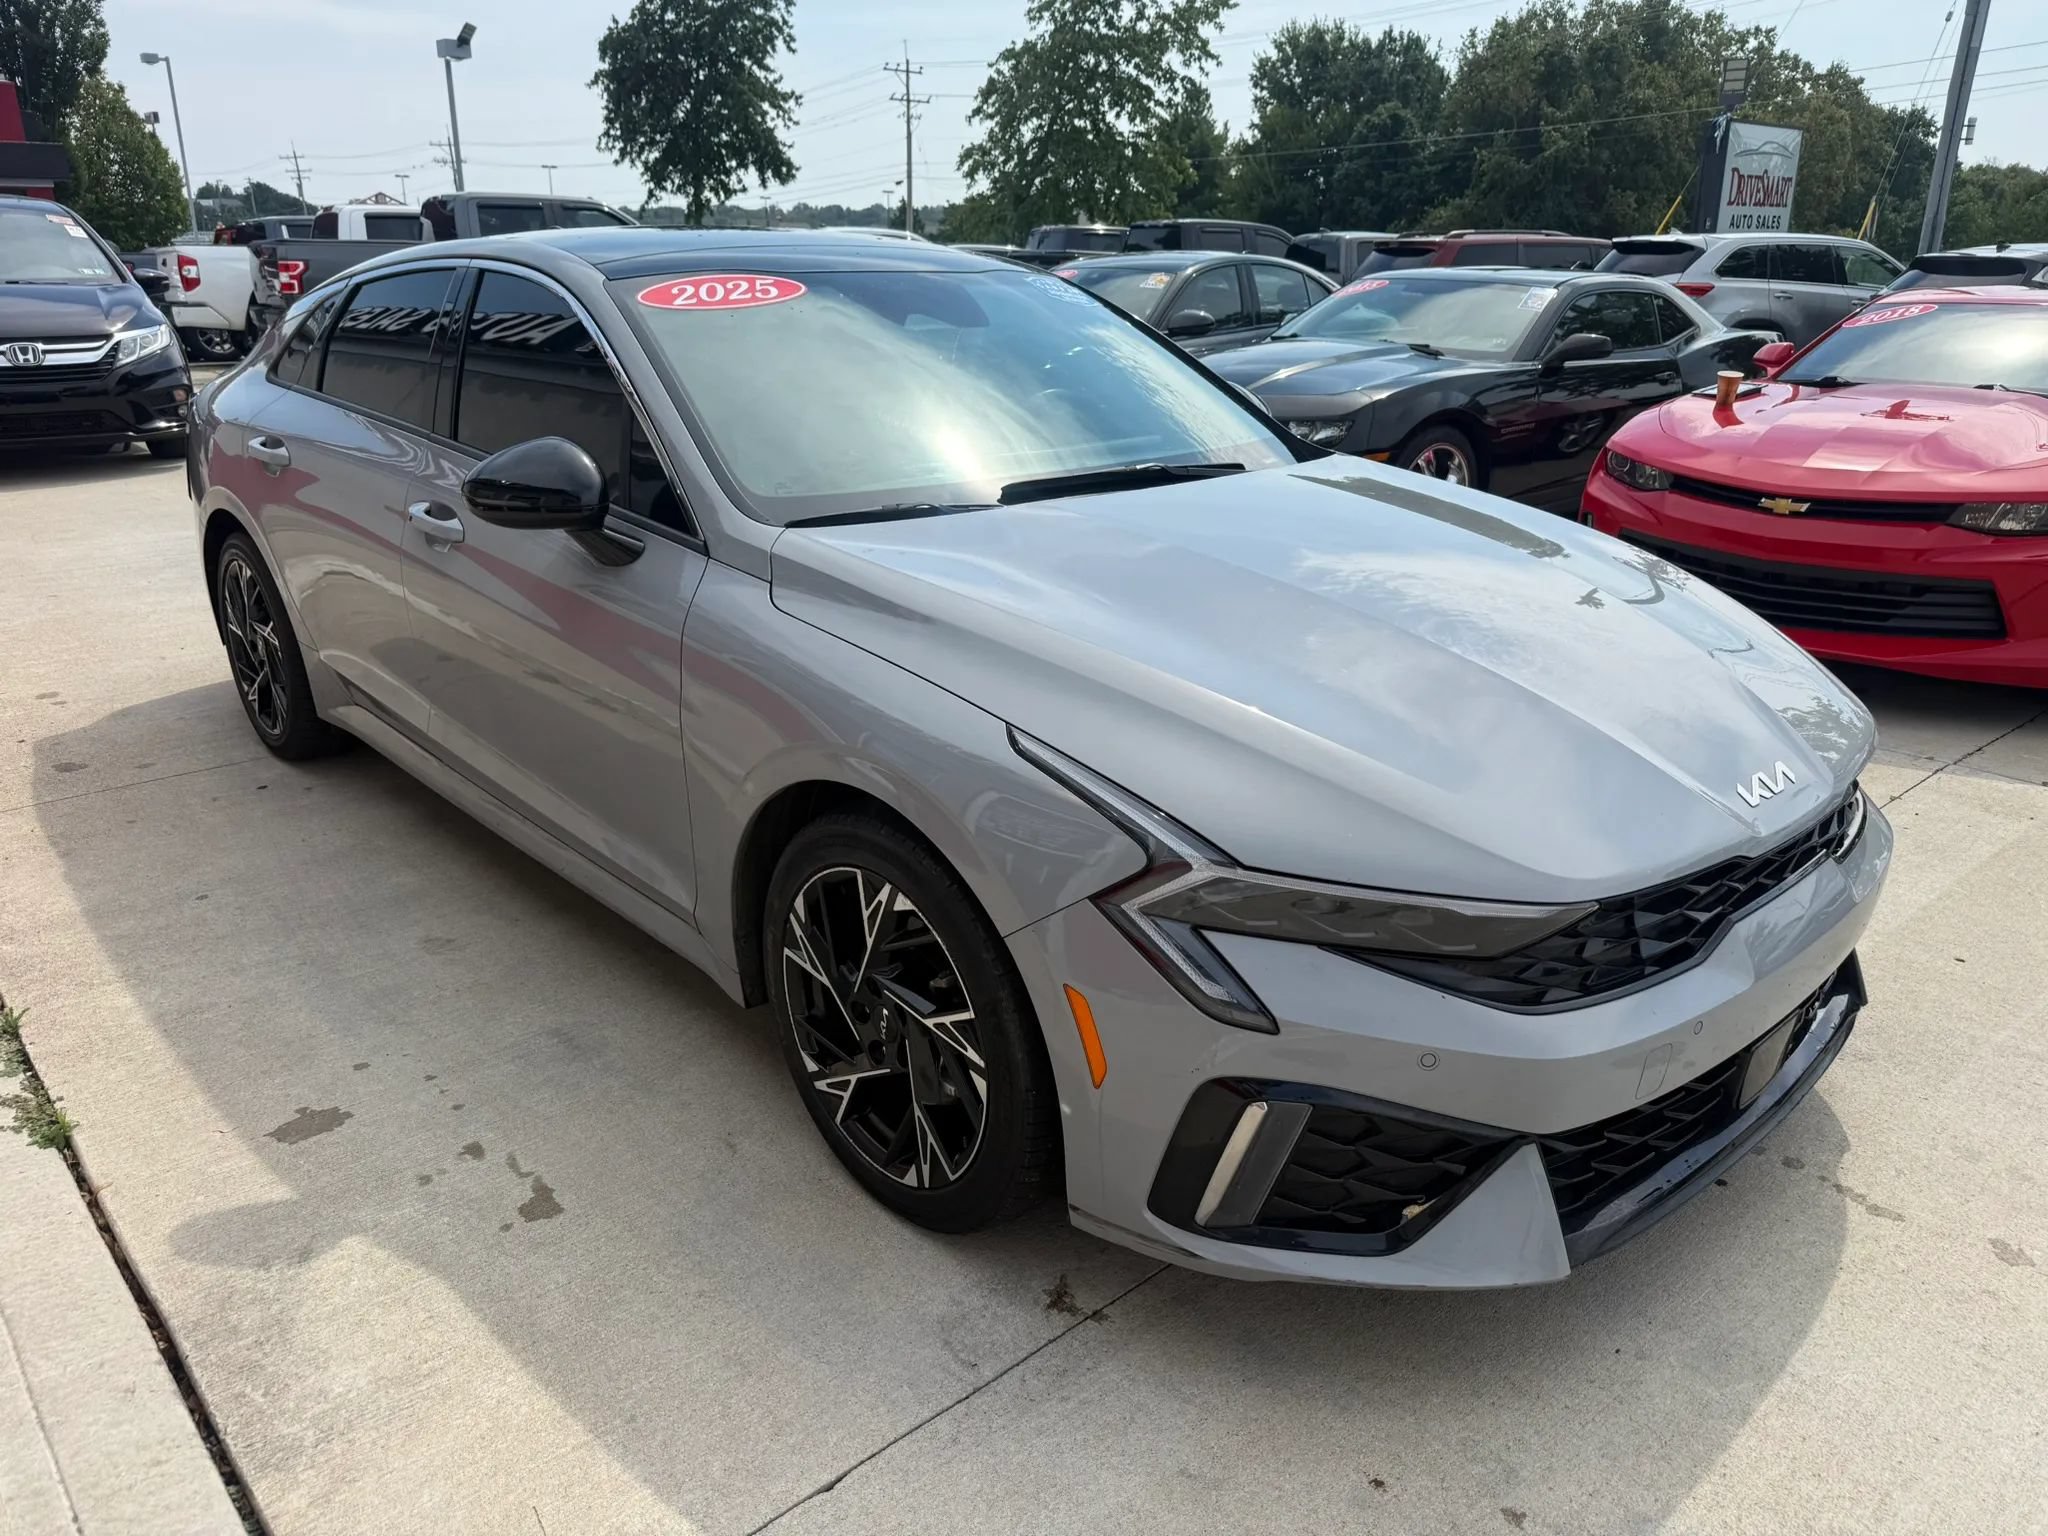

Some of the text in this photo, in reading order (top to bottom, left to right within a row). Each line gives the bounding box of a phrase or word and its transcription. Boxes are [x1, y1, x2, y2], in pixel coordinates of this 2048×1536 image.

[1729, 214, 1782, 230] AUTO SALES
[671, 279, 779, 306] 2025
[1857, 305, 1924, 325] 2018
[1736, 760, 1796, 808] KIA
